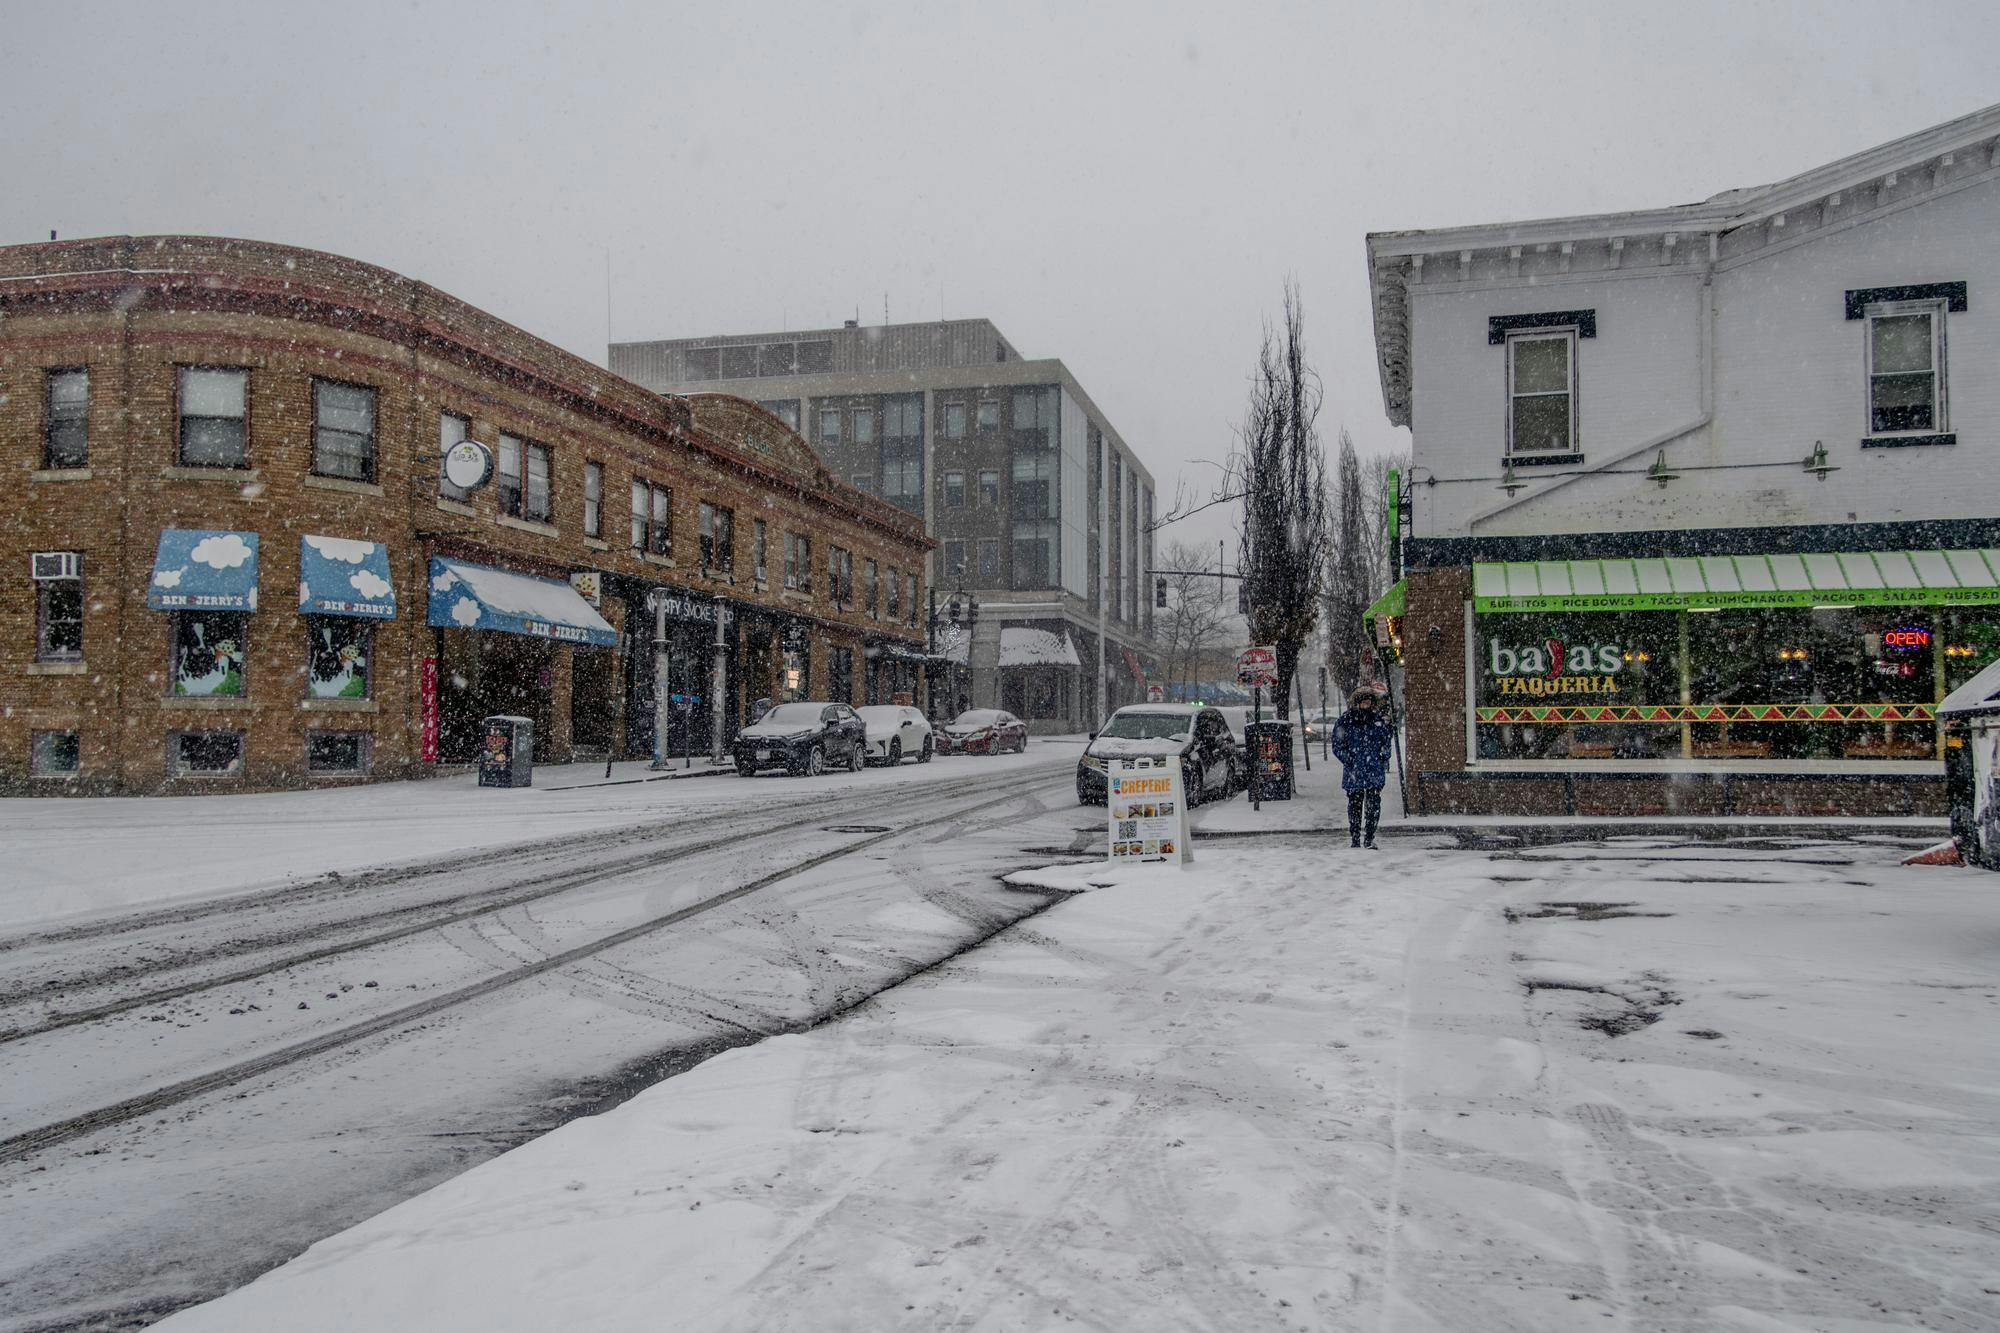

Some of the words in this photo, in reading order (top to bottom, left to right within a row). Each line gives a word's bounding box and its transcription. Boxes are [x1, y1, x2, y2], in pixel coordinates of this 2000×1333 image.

[162, 595, 187, 605] BEN
[195, 595, 243, 606] JERRY'S
[1490, 598, 1547, 609] BURRITOS
[1562, 598, 1591, 608] RICE
[1592, 598, 1635, 607] BOWLS
[1651, 596, 1690, 605] TACOS
[1706, 594, 1795, 604] CHIMICHANGA
[1812, 593, 1865, 602] NACHOS
[1883, 592, 1926, 601] SALAD
[324, 602, 345, 611] BEN
[352, 603, 393, 615] JERRY'S
[683, 602, 712, 621] SMOKE
[531, 622, 549, 636] BEN
[1885, 631, 1927, 646] OPEN
[1496, 676, 1618, 697] TAQUERIA
